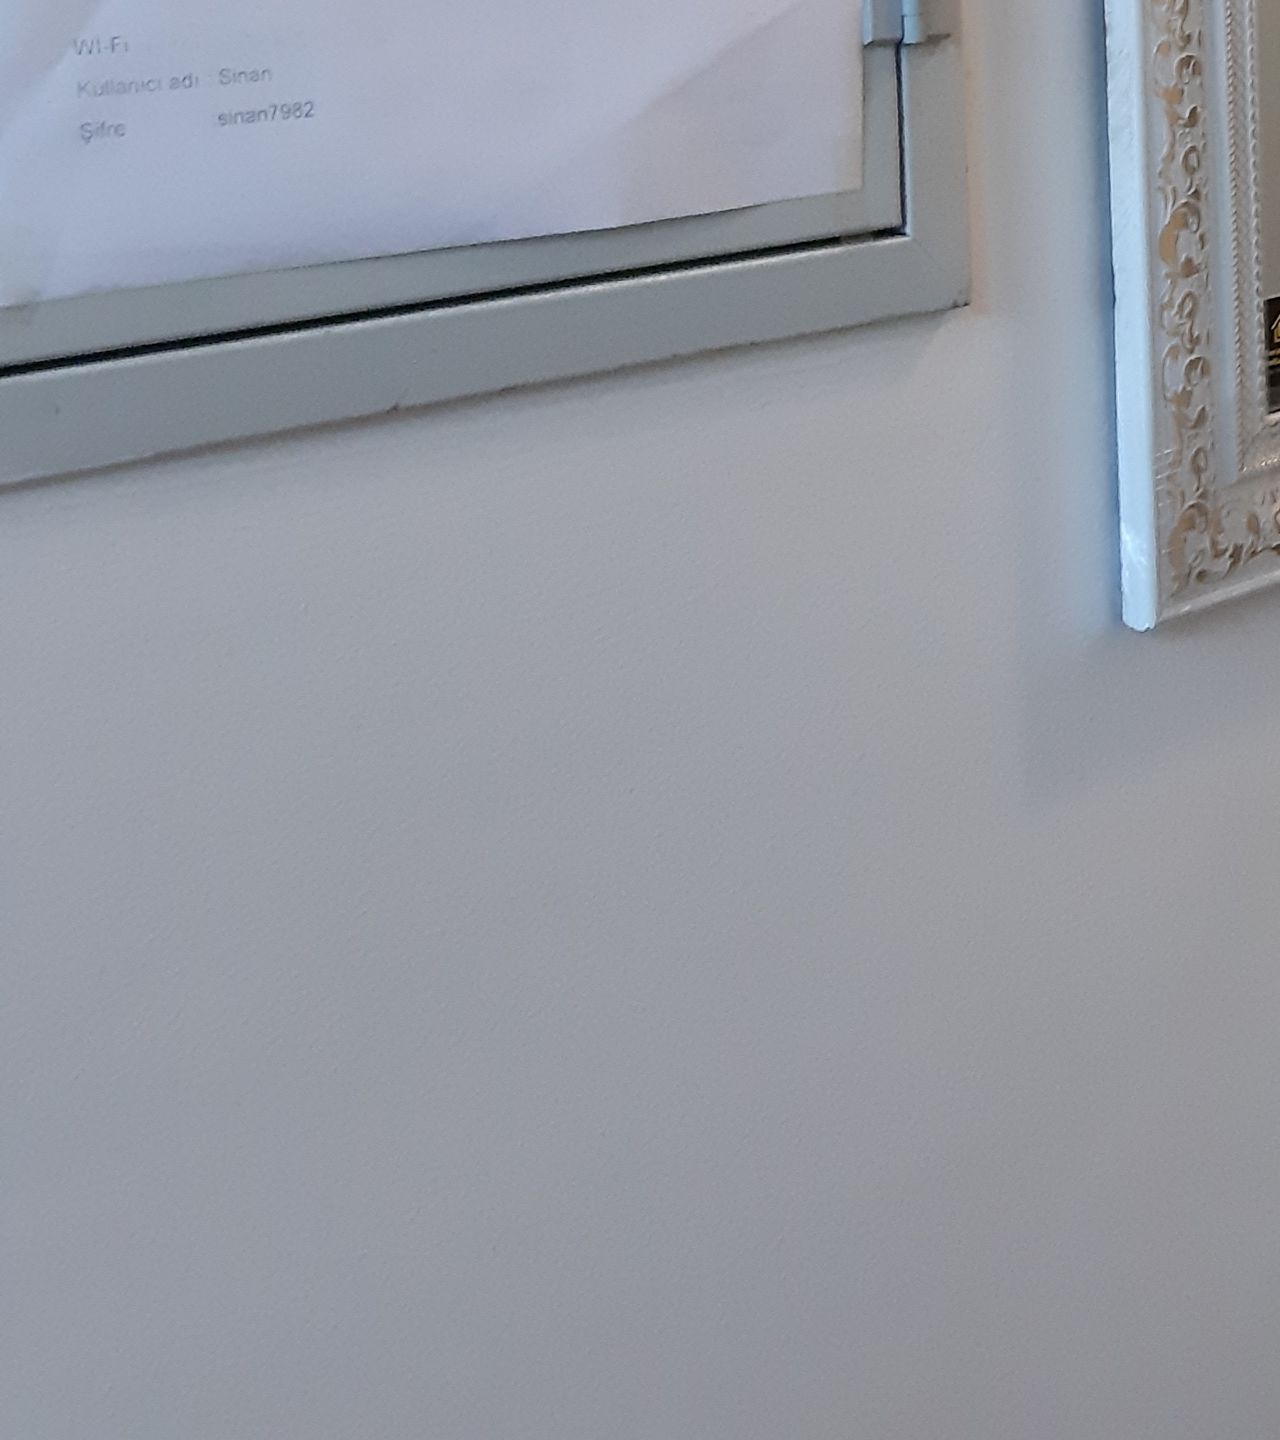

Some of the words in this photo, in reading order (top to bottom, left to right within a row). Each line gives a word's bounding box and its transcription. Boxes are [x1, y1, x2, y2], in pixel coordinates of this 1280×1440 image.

[77, 77, 162, 98] Kullanıcı
[168, 72, 200, 91] adı
[218, 67, 273, 86] Sinan
[79, 119, 127, 145] Şifre
